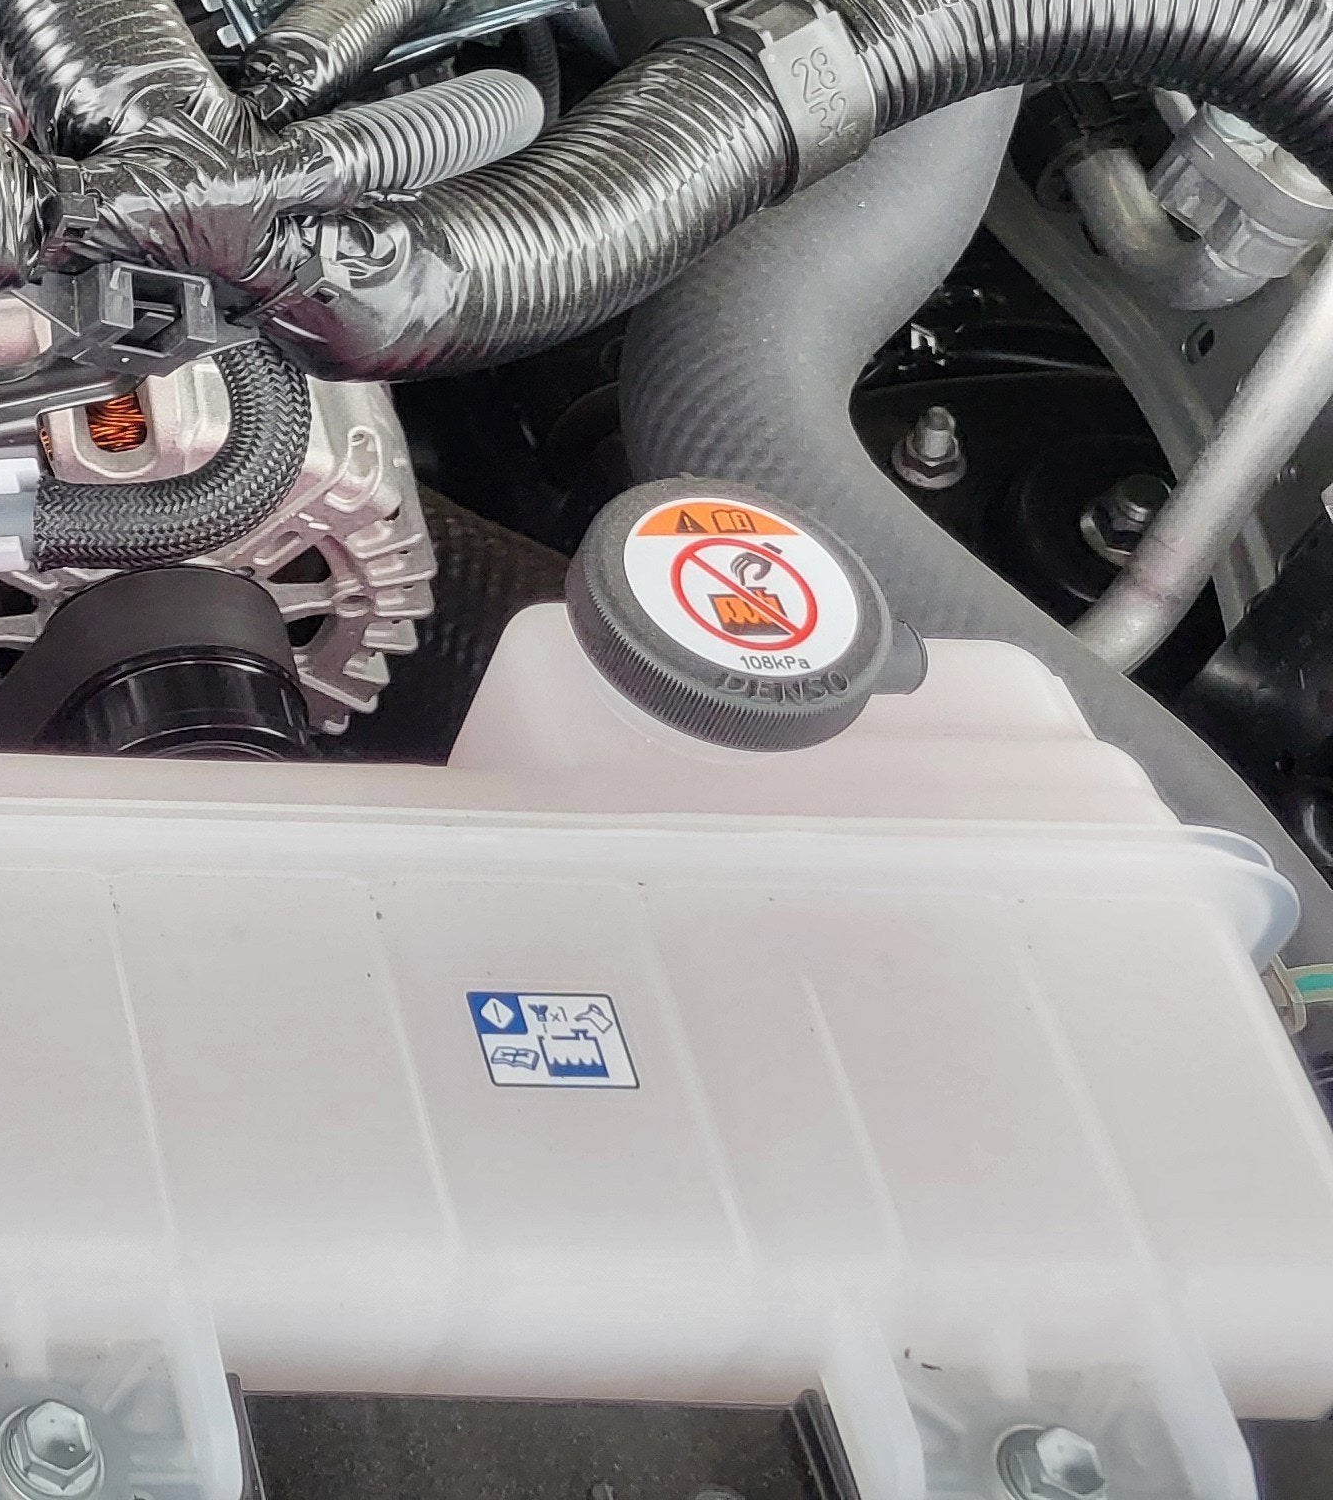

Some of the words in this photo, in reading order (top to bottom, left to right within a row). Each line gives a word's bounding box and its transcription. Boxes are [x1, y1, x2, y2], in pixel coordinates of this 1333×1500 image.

[790, 46, 837, 103] 28
[739, 655, 812, 671] 108kPa
[719, 669, 851, 706] DENSO
